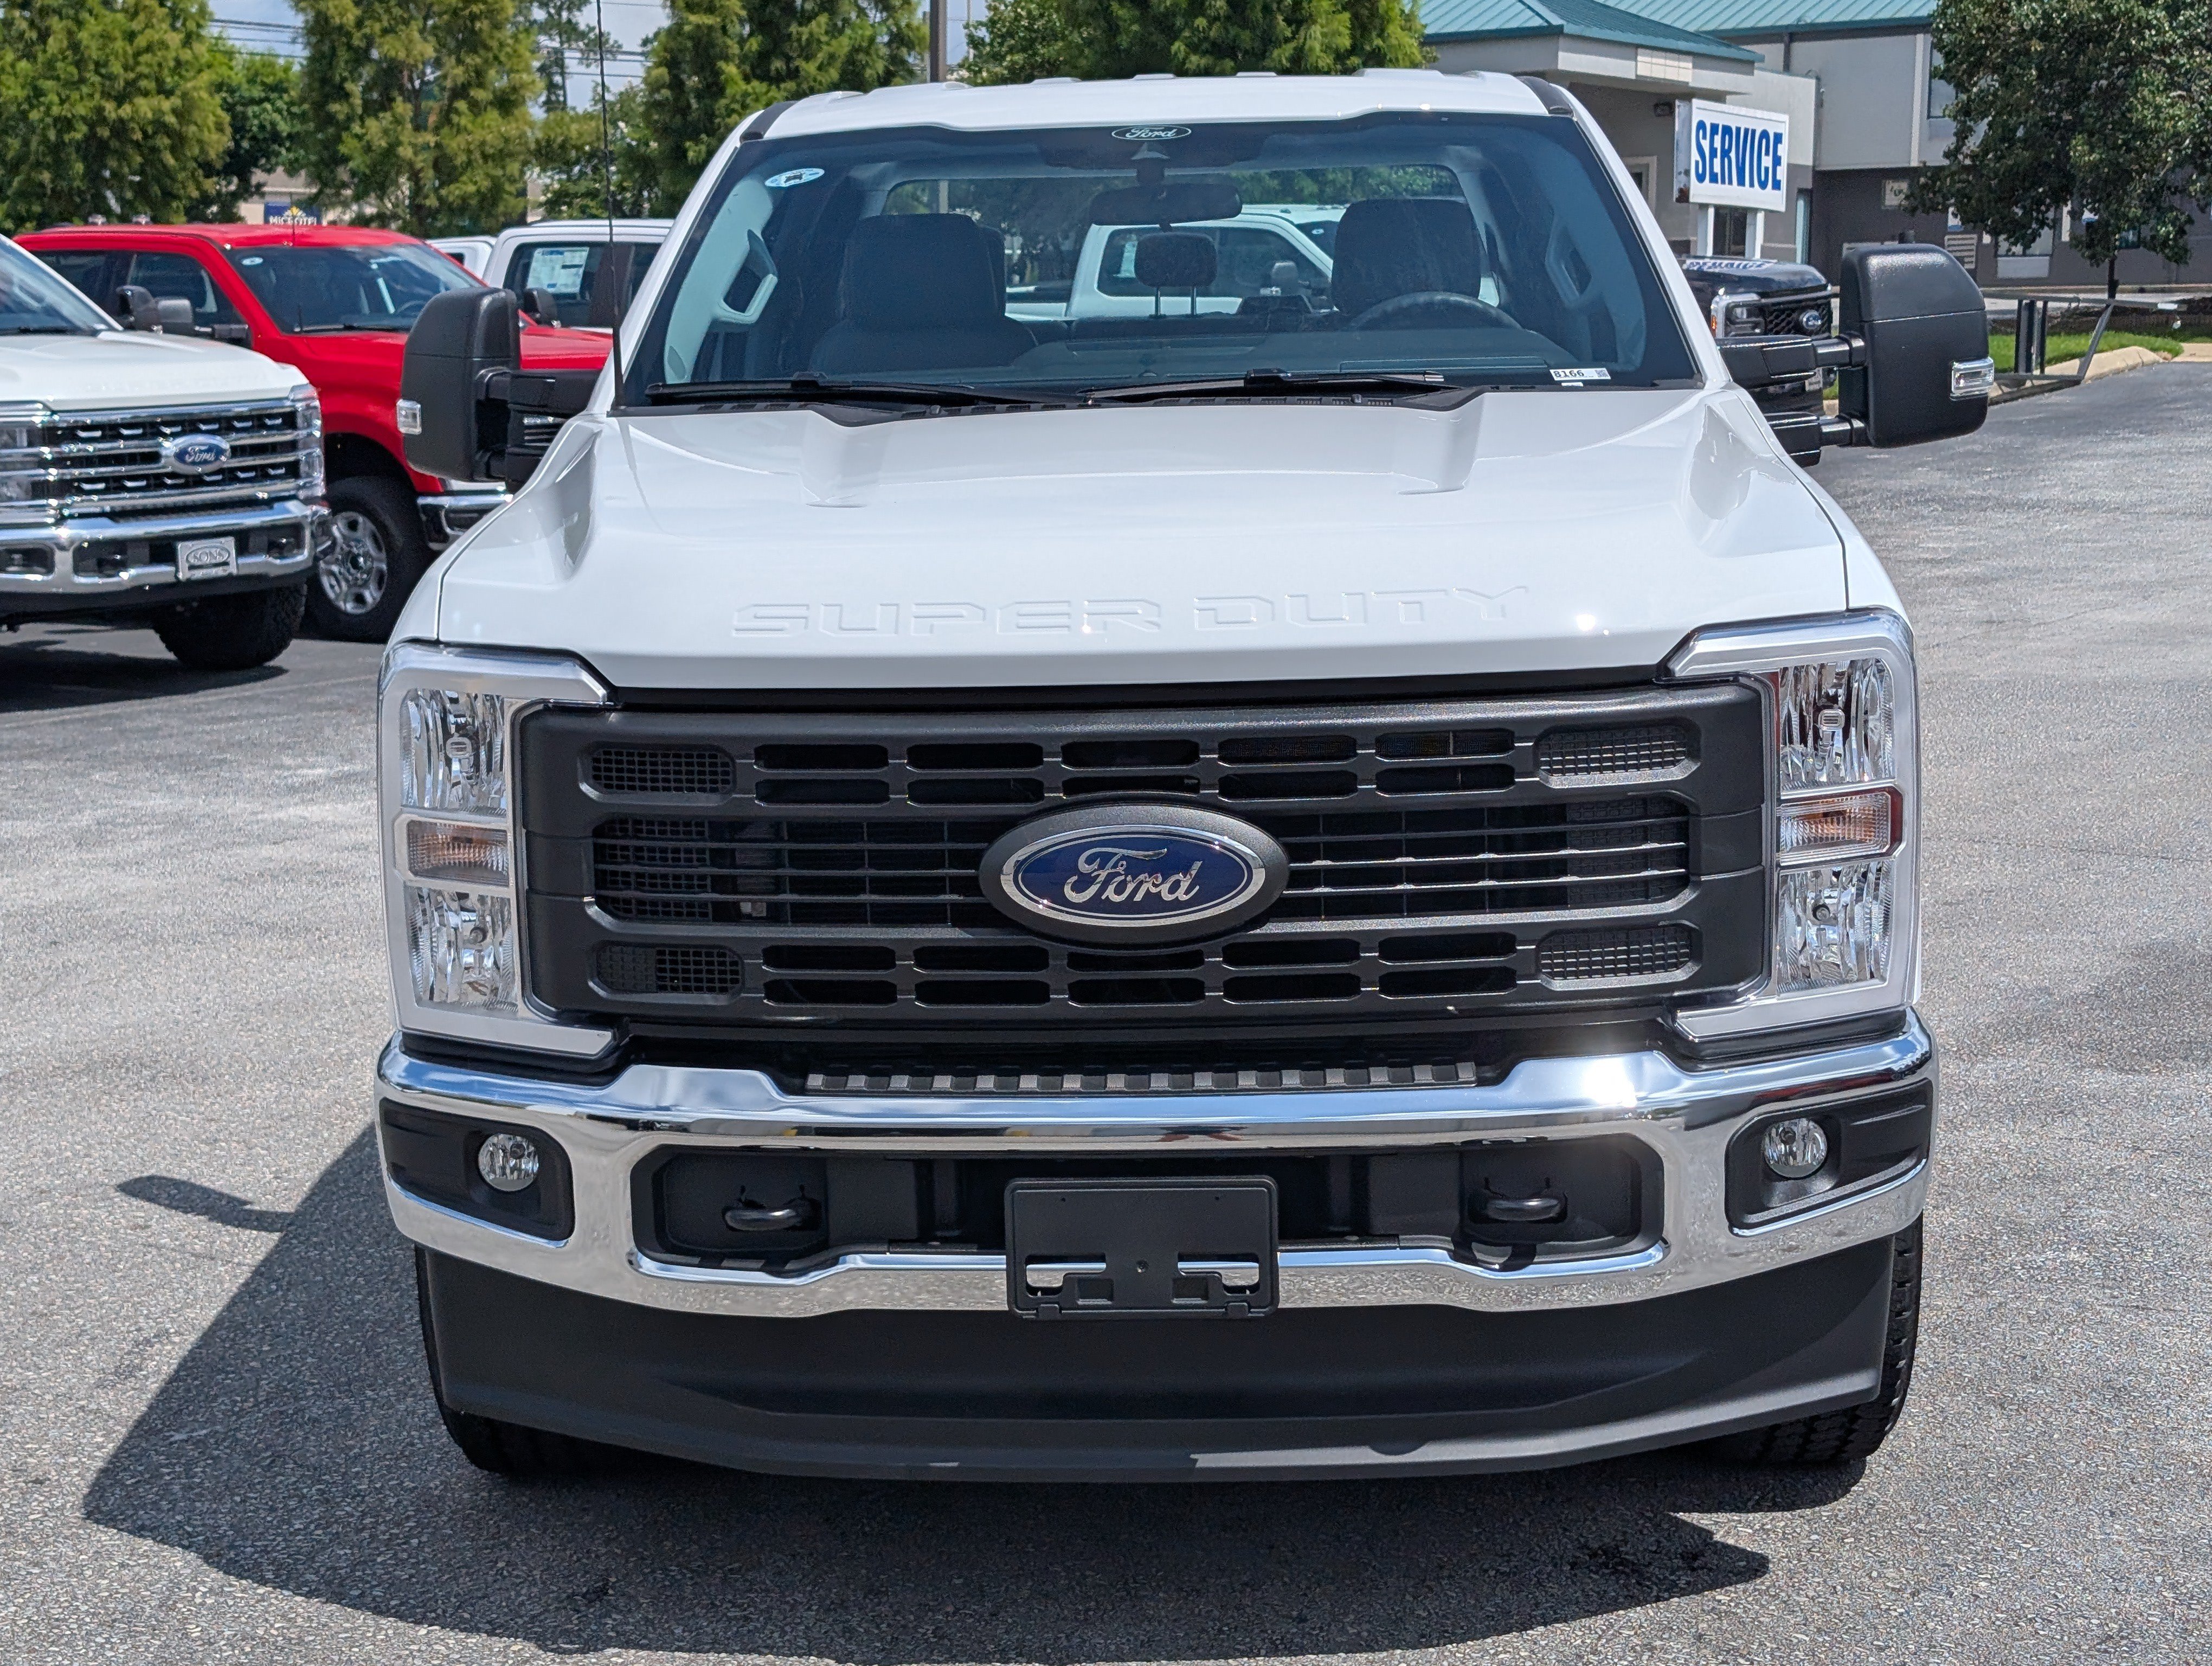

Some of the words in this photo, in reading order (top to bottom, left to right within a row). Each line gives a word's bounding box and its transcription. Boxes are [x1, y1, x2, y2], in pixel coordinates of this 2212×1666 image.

[1126, 126, 1178, 138] Ford
[1695, 119, 1783, 191] SERVICE
[732, 599, 1161, 637] SUPER
[1193, 585, 1528, 631] DUTY
[1064, 847, 1203, 903] Ford
